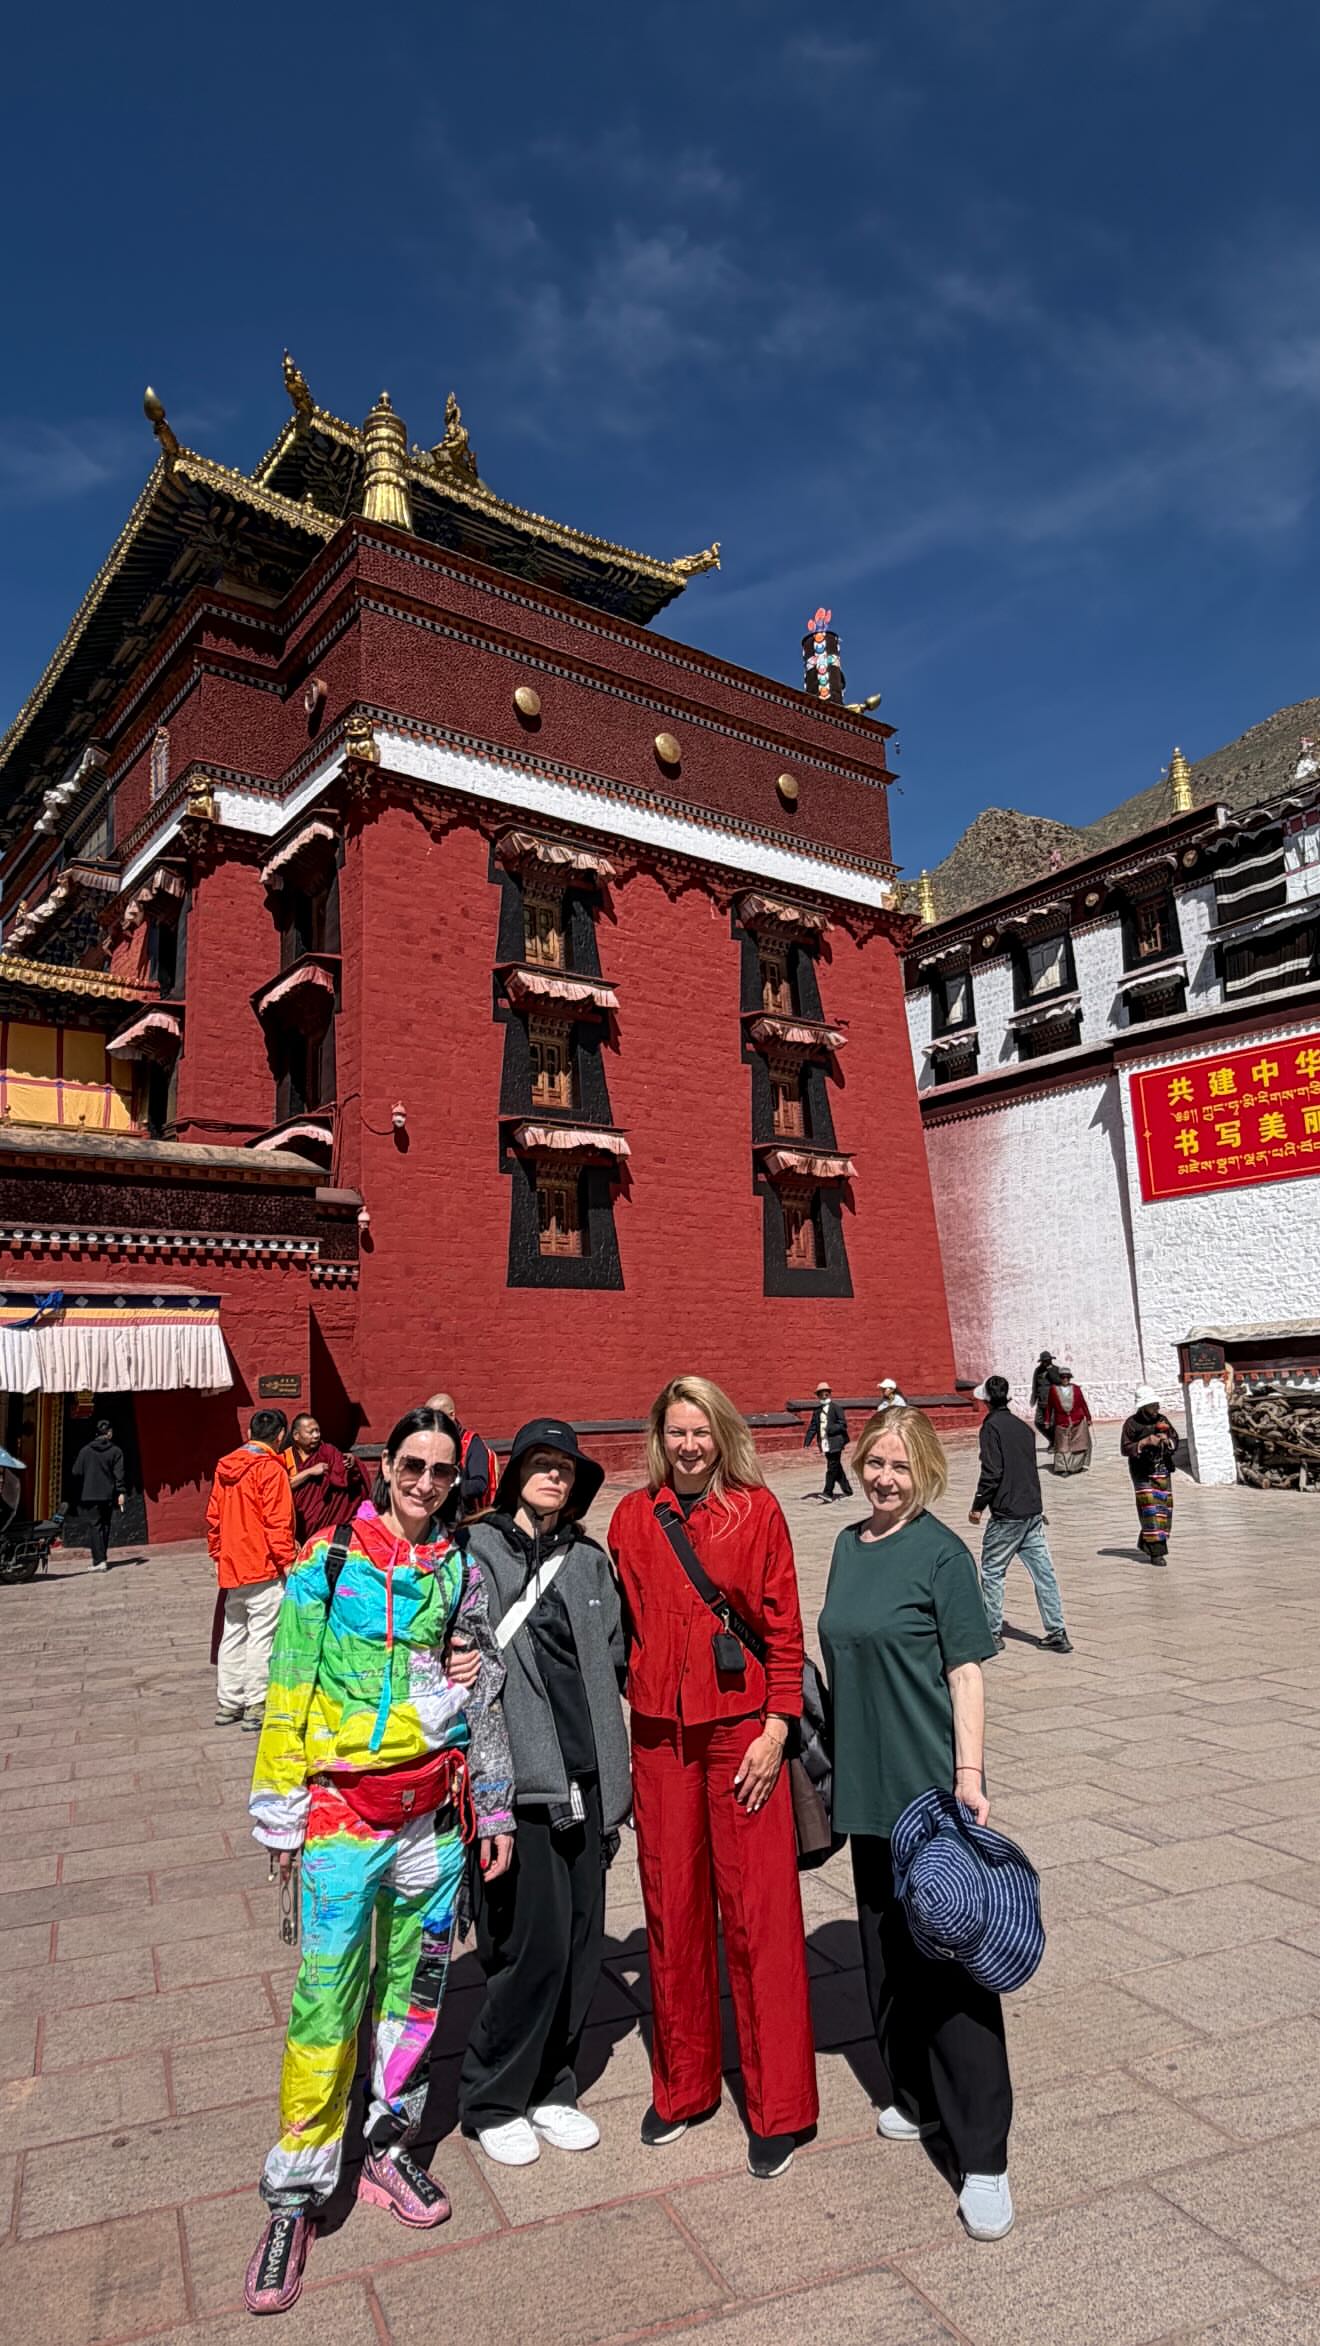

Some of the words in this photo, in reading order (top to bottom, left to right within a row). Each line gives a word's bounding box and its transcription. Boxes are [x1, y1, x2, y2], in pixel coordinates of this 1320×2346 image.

[1167, 1048, 1320, 1106] 共建中华
[1173, 1105, 1320, 1157] 书写美丽
[262, 2218, 290, 2289] GABBANA
